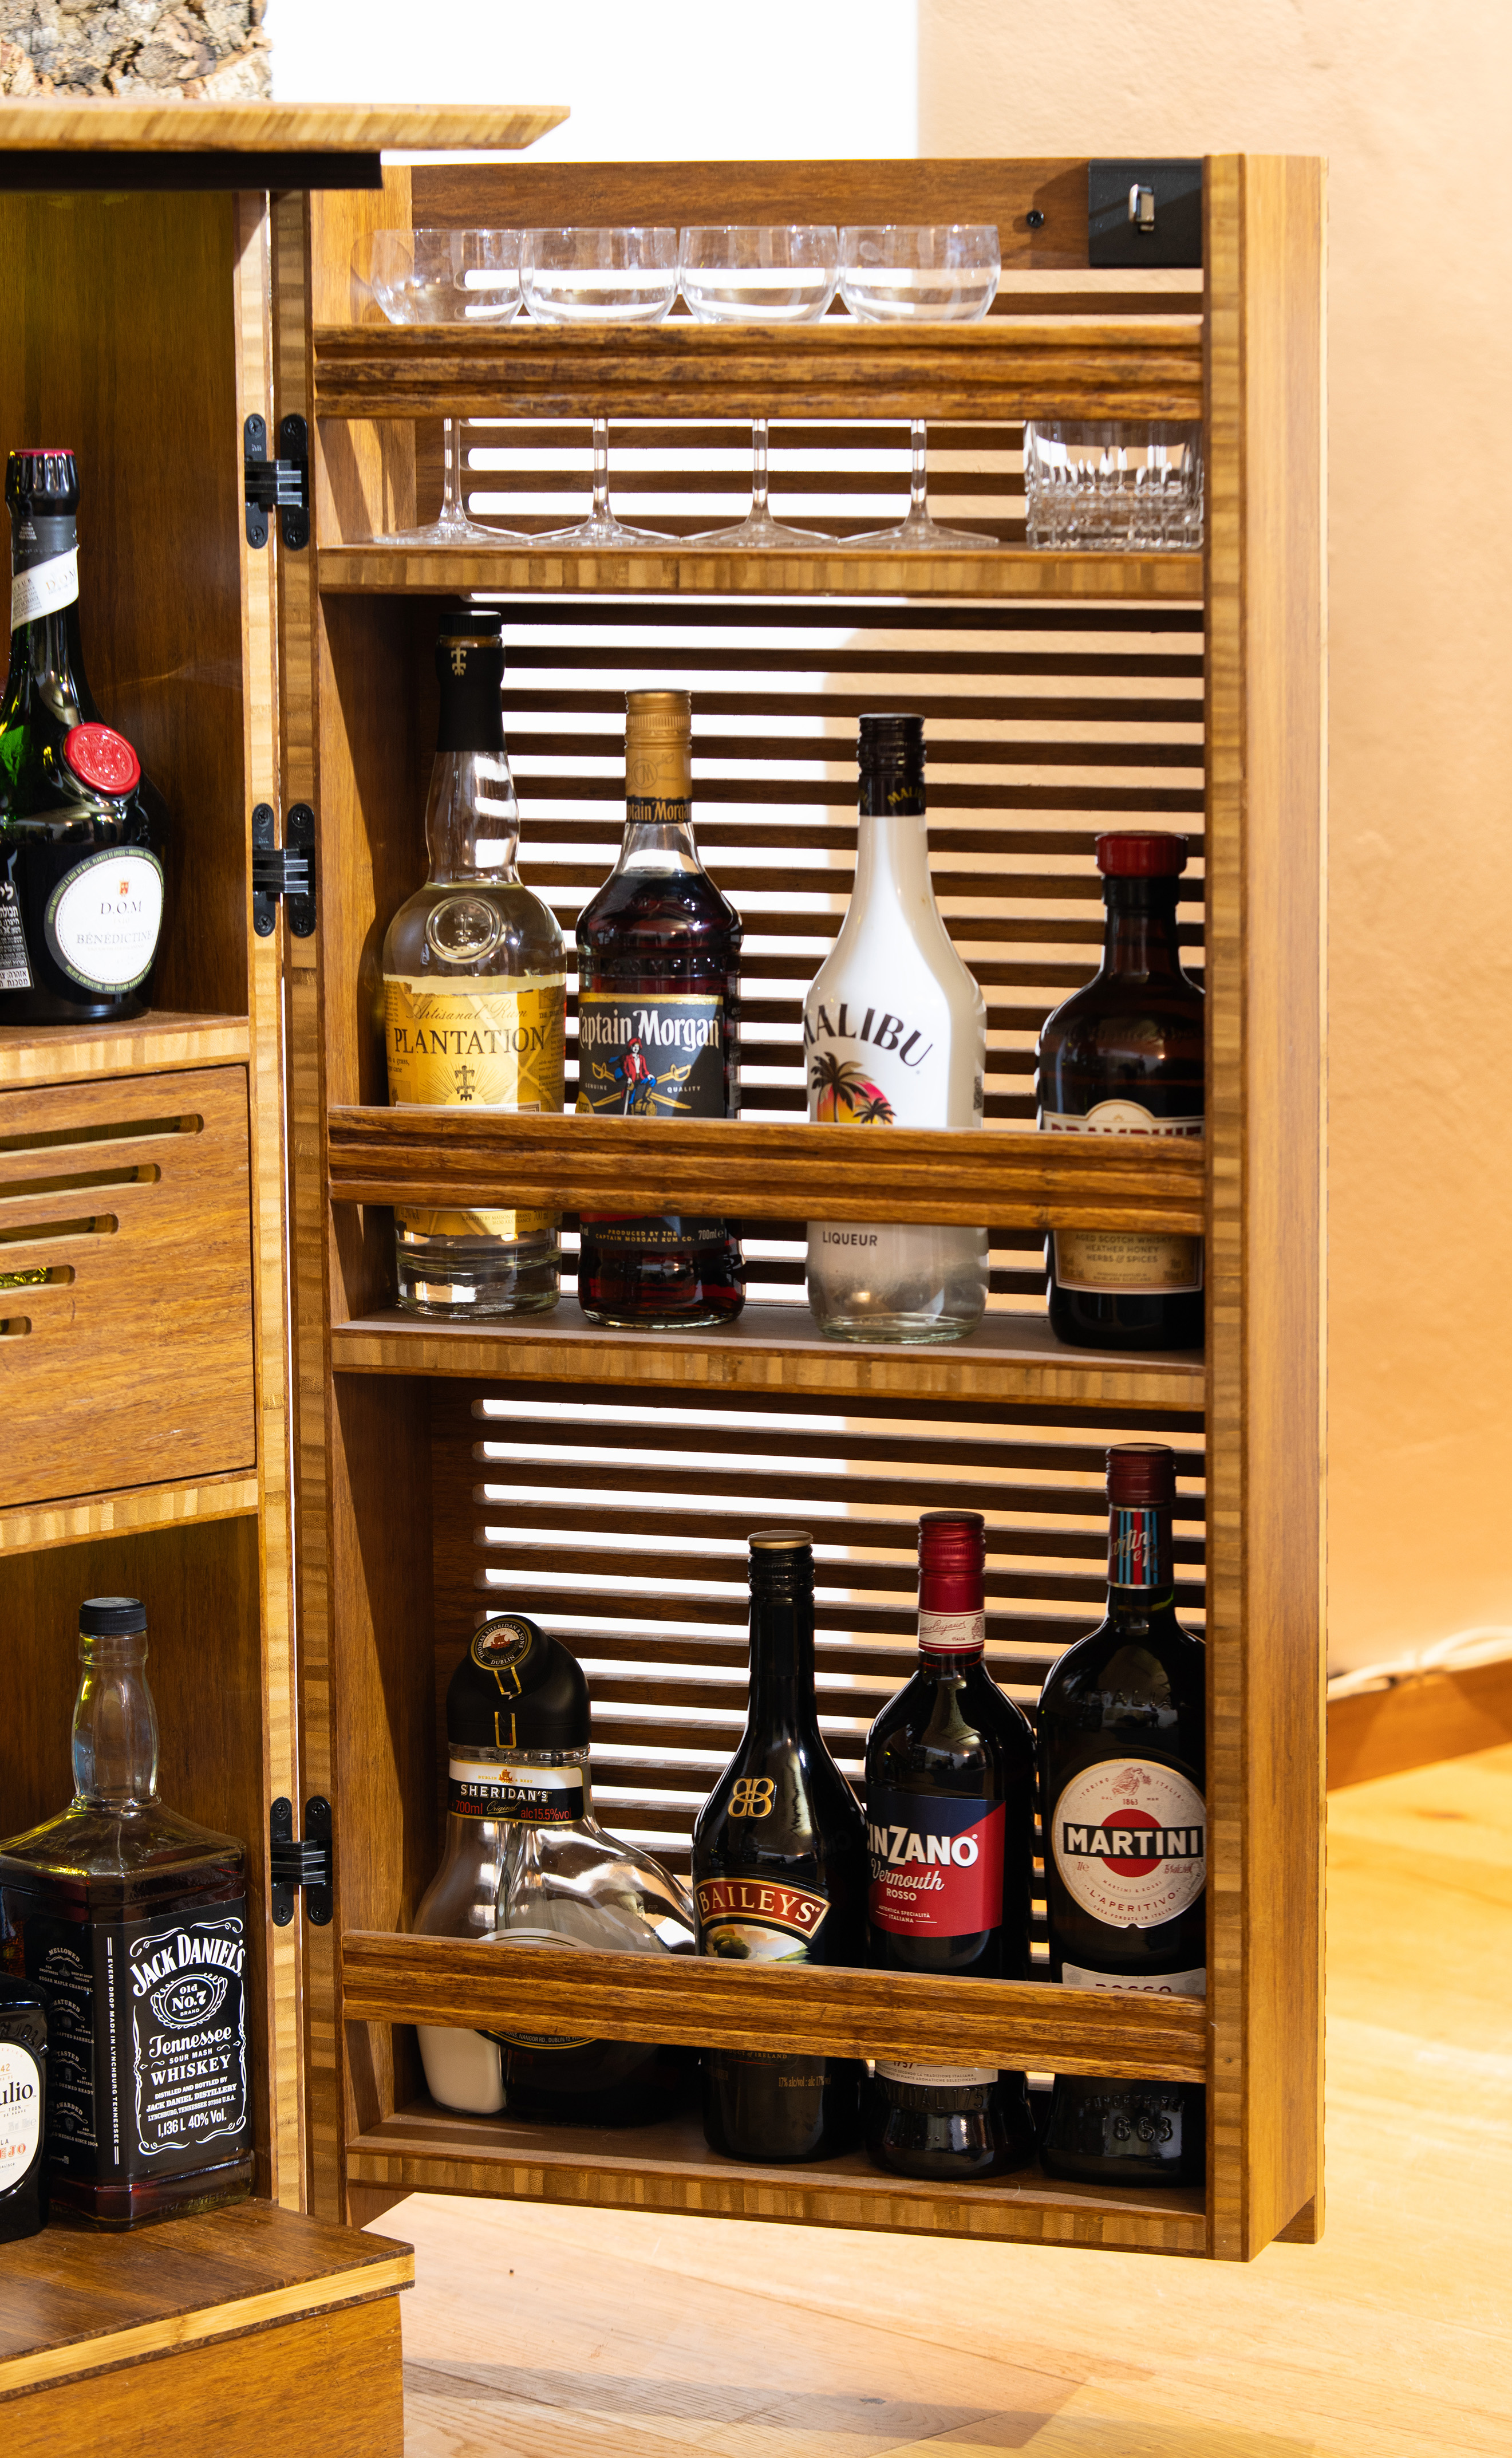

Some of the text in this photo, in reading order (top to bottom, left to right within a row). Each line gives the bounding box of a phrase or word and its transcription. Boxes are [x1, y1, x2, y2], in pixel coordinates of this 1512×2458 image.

[406, 998, 527, 1020] Artisanal Rum
[579, 1007, 719, 1052] Captain Morgan
[394, 1025, 545, 1055] PLANTATION
[595, 1233, 622, 1242] CAPTAIN
[607, 1228, 646, 1236] PRODUCED
[822, 1231, 878, 1247] LIQUEUR
[1099, 1235, 1134, 1243] SCOTCH
[1085, 1244, 1159, 1254] HEATHER HONEY
[1086, 1254, 1114, 1262] HERBS
[1126, 1255, 1158, 1263] SPICES
[477, 1634, 486, 1659] THOMAS
[485, 1623, 518, 1635] SHERIDAN
[491, 1655, 515, 1665] DUBLIN
[460, 1784, 548, 1803] SHERIDAN'S
[1081, 1778, 1109, 1796] TORINO
[1155, 1780, 1182, 1799] ITALIA
[486, 1800, 521, 1815] Original
[867, 1825, 979, 1867] INZANO
[1067, 1825, 1199, 1856] MARTINI
[871, 1857, 945, 1891] Vermouth
[886, 1888, 917, 1901] ROSSO
[1103, 1880, 1132, 1893] MARTINI
[1142, 1881, 1162, 1892] ROSSI
[698, 1886, 817, 1923] BAILEYS
[1089, 1889, 1176, 1912] L'APERITIVO
[878, 1904, 930, 1919] AUTENTICA SPECIALITÀ
[888, 1914, 914, 1923] ITALIANA
[1093, 1905, 1108, 1916] CASA
[1110, 1913, 1138, 1921] FONDATA
[1151, 1907, 1173, 1919] ITALIA
[48, 1947, 80, 1963] MELLOWED
[129, 1945, 177, 1998] JACK
[54, 1979, 68, 1987] MAPLE
[69, 1983, 93, 1992] CHARCOAL
[179, 1983, 198, 1995] Old
[180, 2008, 200, 2017] BRAND
[73, 2035, 94, 2044] BARRELS
[148, 2027, 232, 2058] Tennessee
[519, 2034, 539, 2042] NANGOR
[57, 2050, 80, 2062] TASTED
[169, 2048, 213, 2065] SOUR MASH
[151, 2054, 231, 2086] WHISKEY
[59, 2082, 94, 2095] DEEMED READY
[778, 2077, 788, 2087] 17%
[816, 2075, 825, 2086] 17%
[0, 2081, 33, 2106] ulio
[155, 2087, 182, 2100] DISTILLED
[182, 2085, 194, 2093] AND
[194, 2079, 219, 2090] BOTTLED
[146, 2083, 238, 2113] JACK DANIEL DISTILLERY
[56, 2102, 83, 2116] AWARDED
[148, 2094, 236, 2122] LYNCHBURG, TENNESSEE 37352 U.S.A.
[157, 2108, 227, 2138] 1,136 L 40% Vol.
[58, 2133, 74, 2142] MEDALS
[77, 2129, 96, 2138] DISTINCTION
[0, 2143, 26, 2160] EJO
